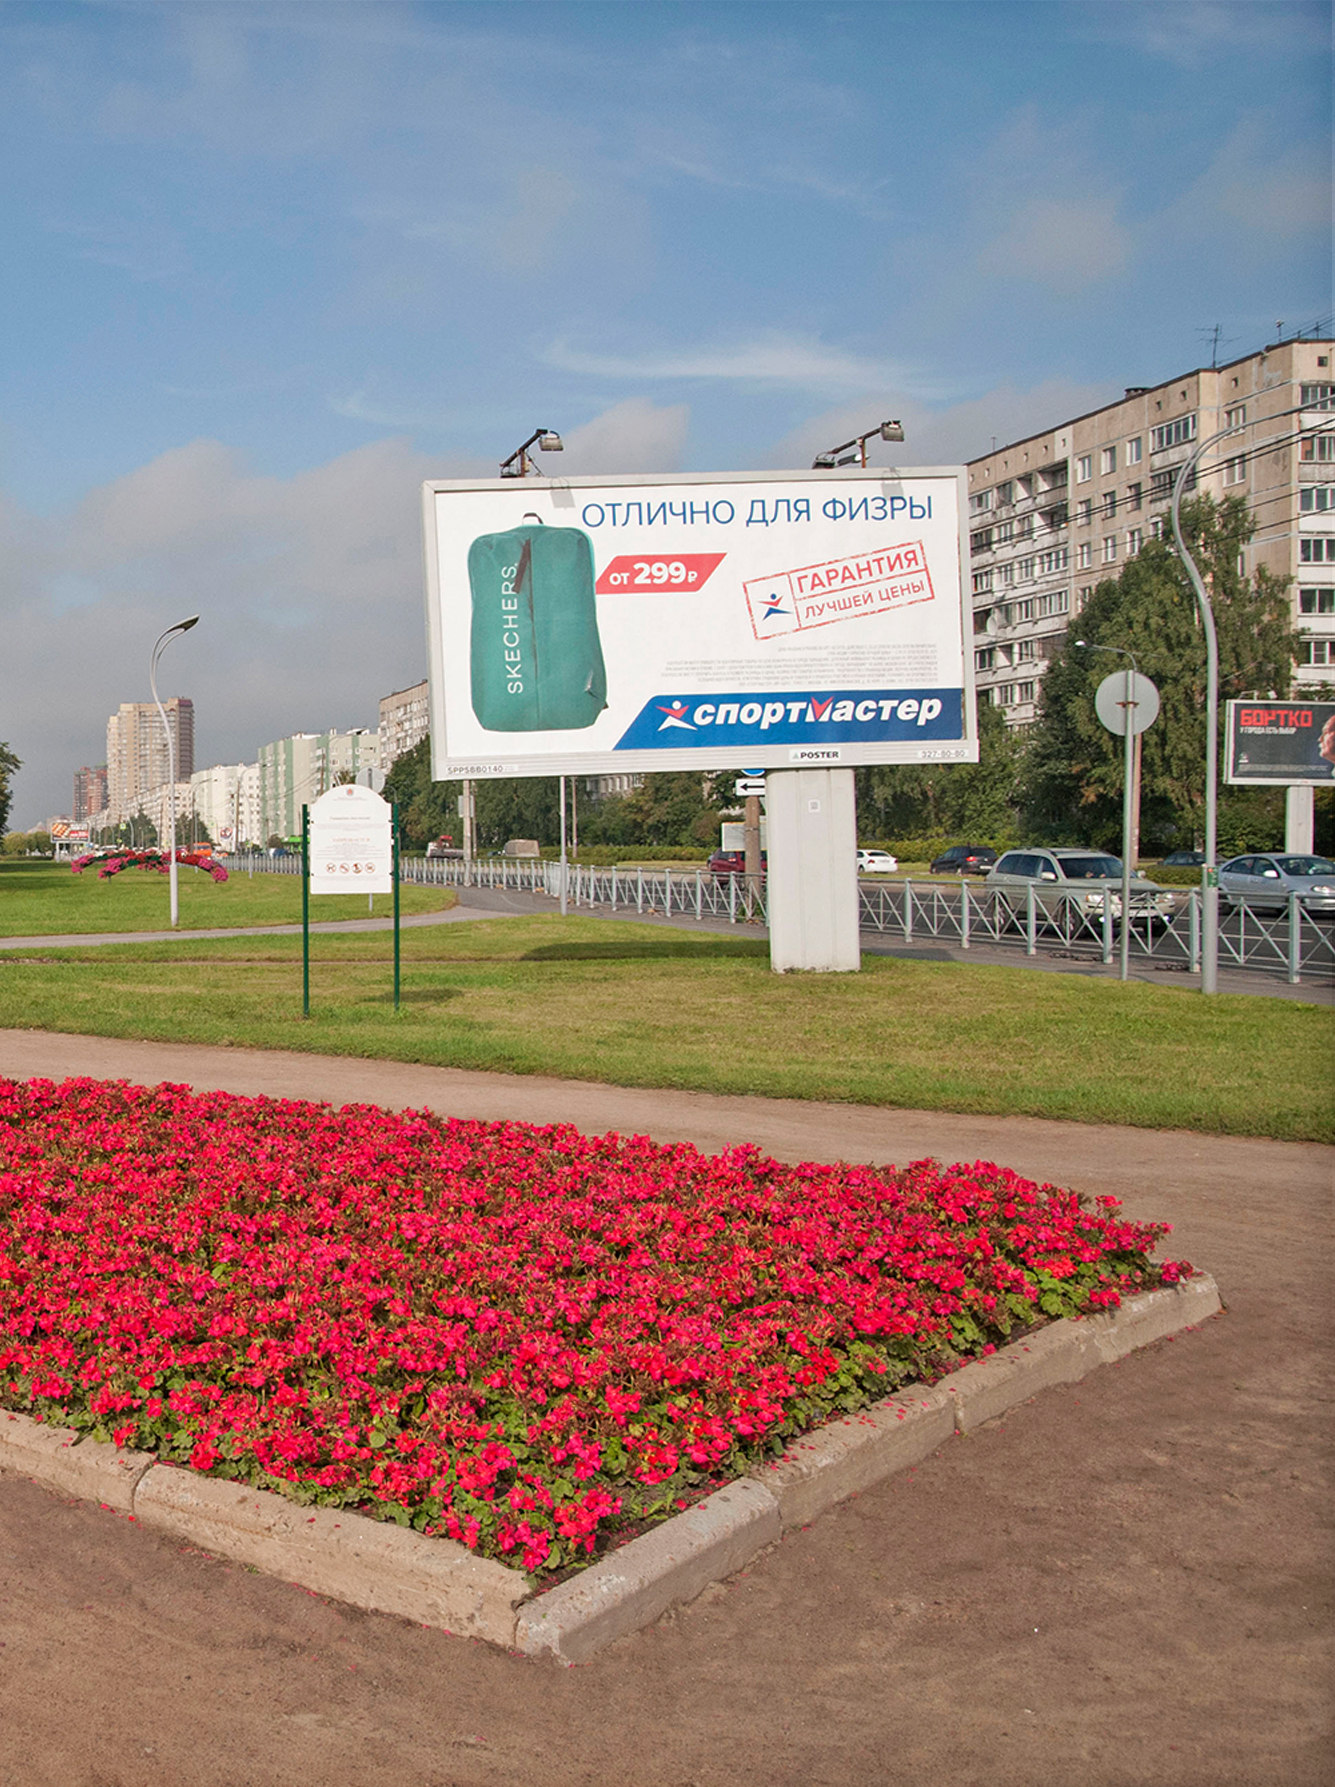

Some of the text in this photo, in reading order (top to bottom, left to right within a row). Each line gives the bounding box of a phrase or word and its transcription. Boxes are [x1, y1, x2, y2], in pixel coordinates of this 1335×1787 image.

[582, 496, 932, 528] ОТЛИЧНО ДЛЯ ФИЗРЫ
[797, 549, 919, 593] ГАРАНТИЯ
[805, 580, 925, 619] ЛУЧШЕЙ ЦЕНЫ
[501, 565, 523, 694] SKECHERS
[1240, 709, 1313, 727] БОРТКО
[800, 751, 839, 759] POSTER
